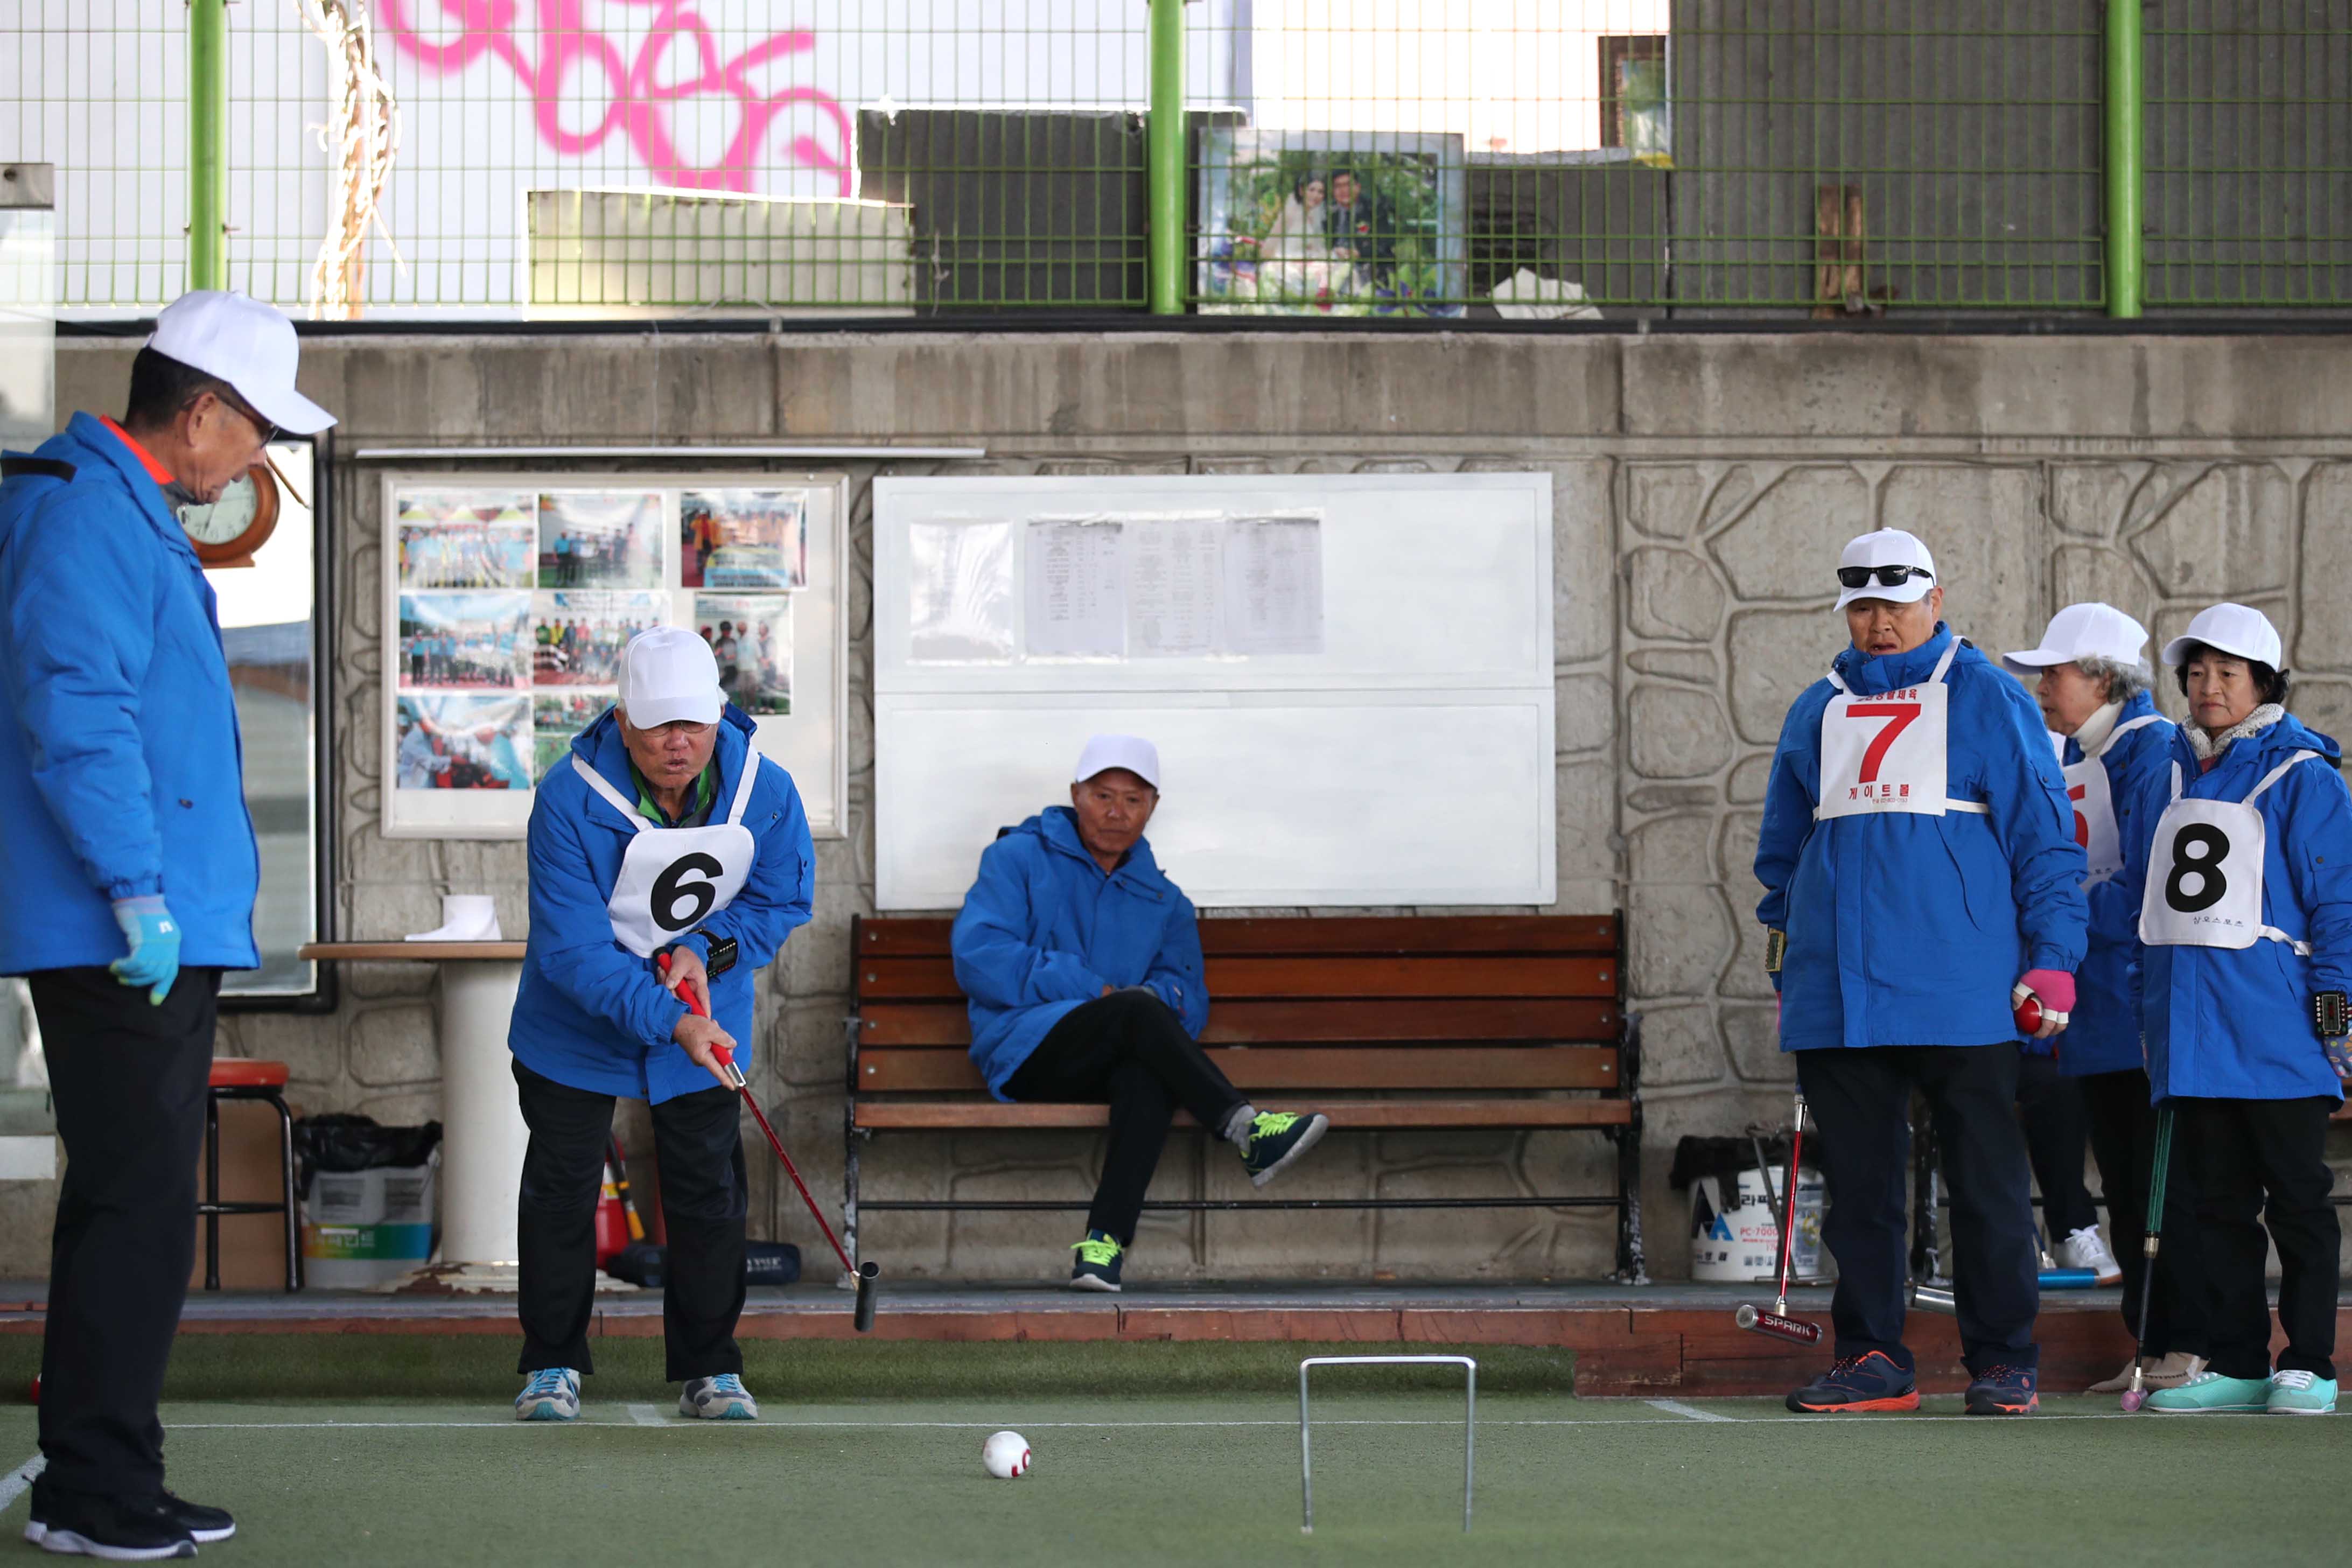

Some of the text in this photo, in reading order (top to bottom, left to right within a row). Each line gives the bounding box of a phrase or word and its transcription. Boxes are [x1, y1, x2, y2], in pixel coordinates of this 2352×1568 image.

[1846, 703, 1922, 783] 7
[651, 853, 723, 931] 6
[2165, 823, 2229, 912] 8
[1765, 1315, 1810, 1336] SPARK
